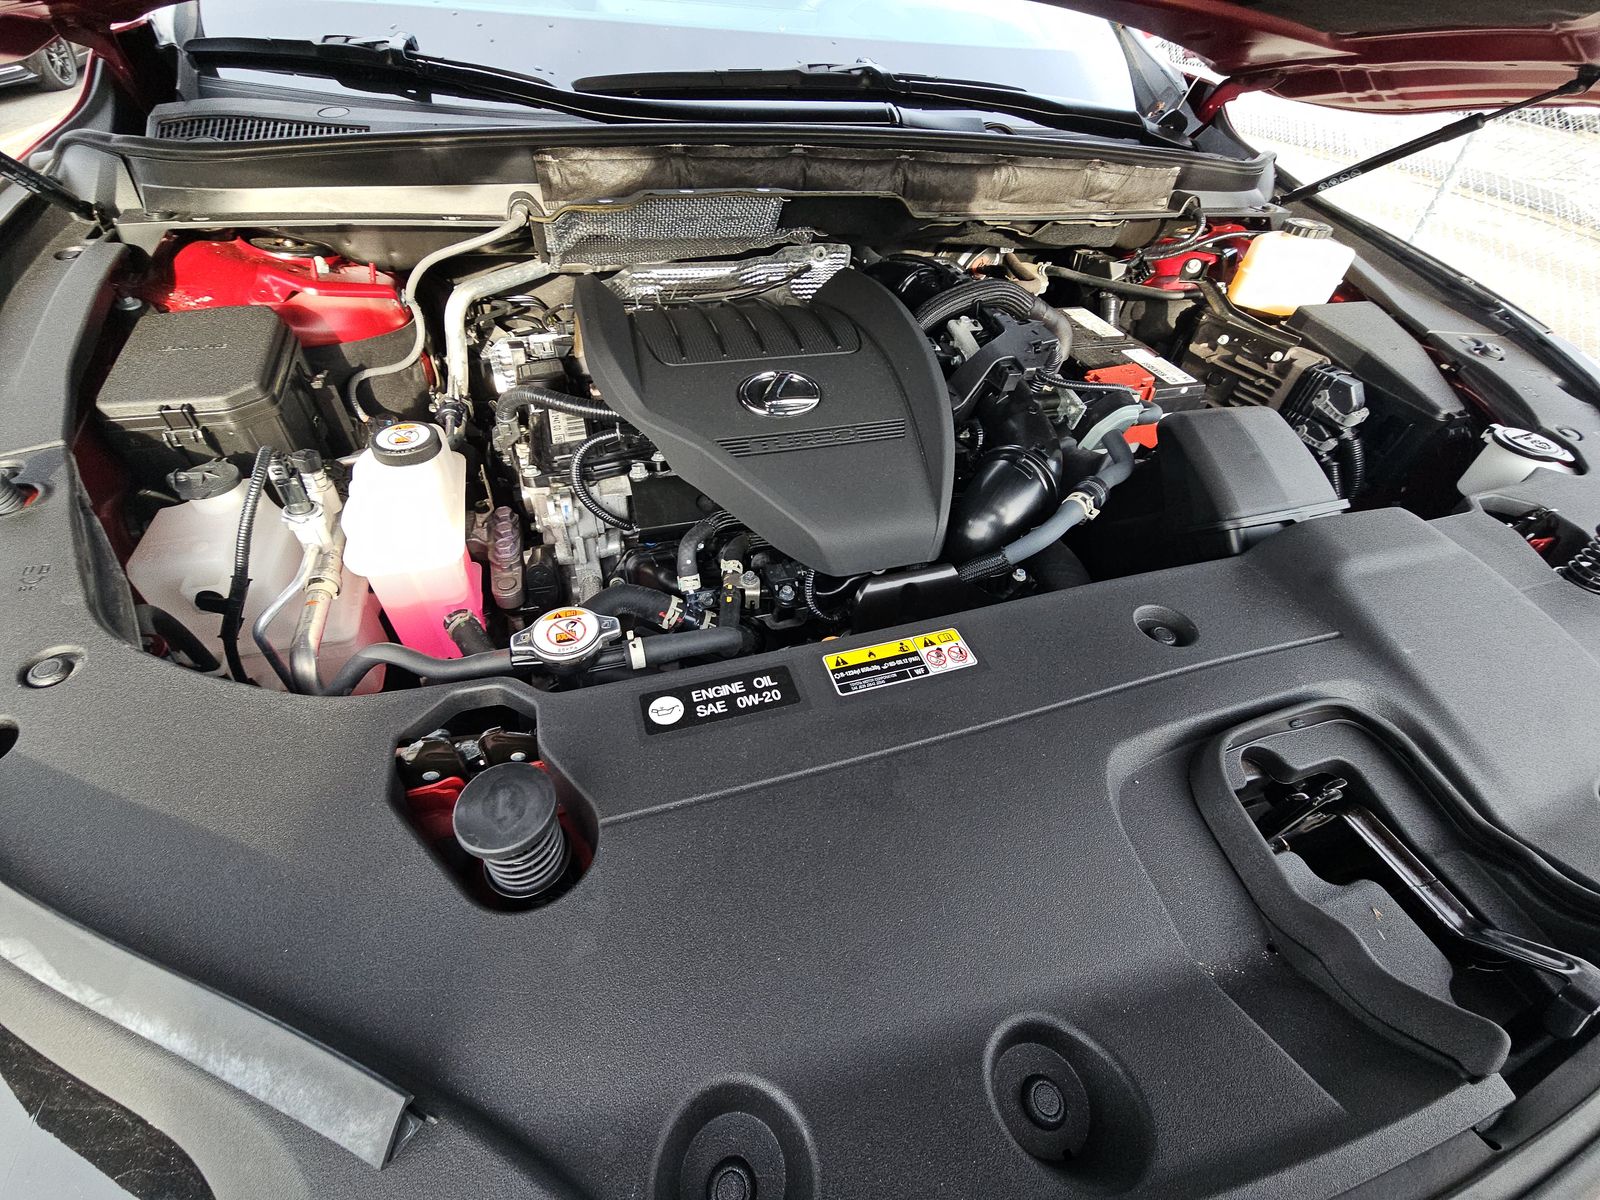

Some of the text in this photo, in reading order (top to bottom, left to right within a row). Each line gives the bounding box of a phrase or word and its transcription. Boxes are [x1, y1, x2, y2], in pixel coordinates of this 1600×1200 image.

[750, 428, 855, 450] TURBO
[691, 675, 778, 702] ENGINE OIL
[696, 689, 781, 718] SAE 0W-20
